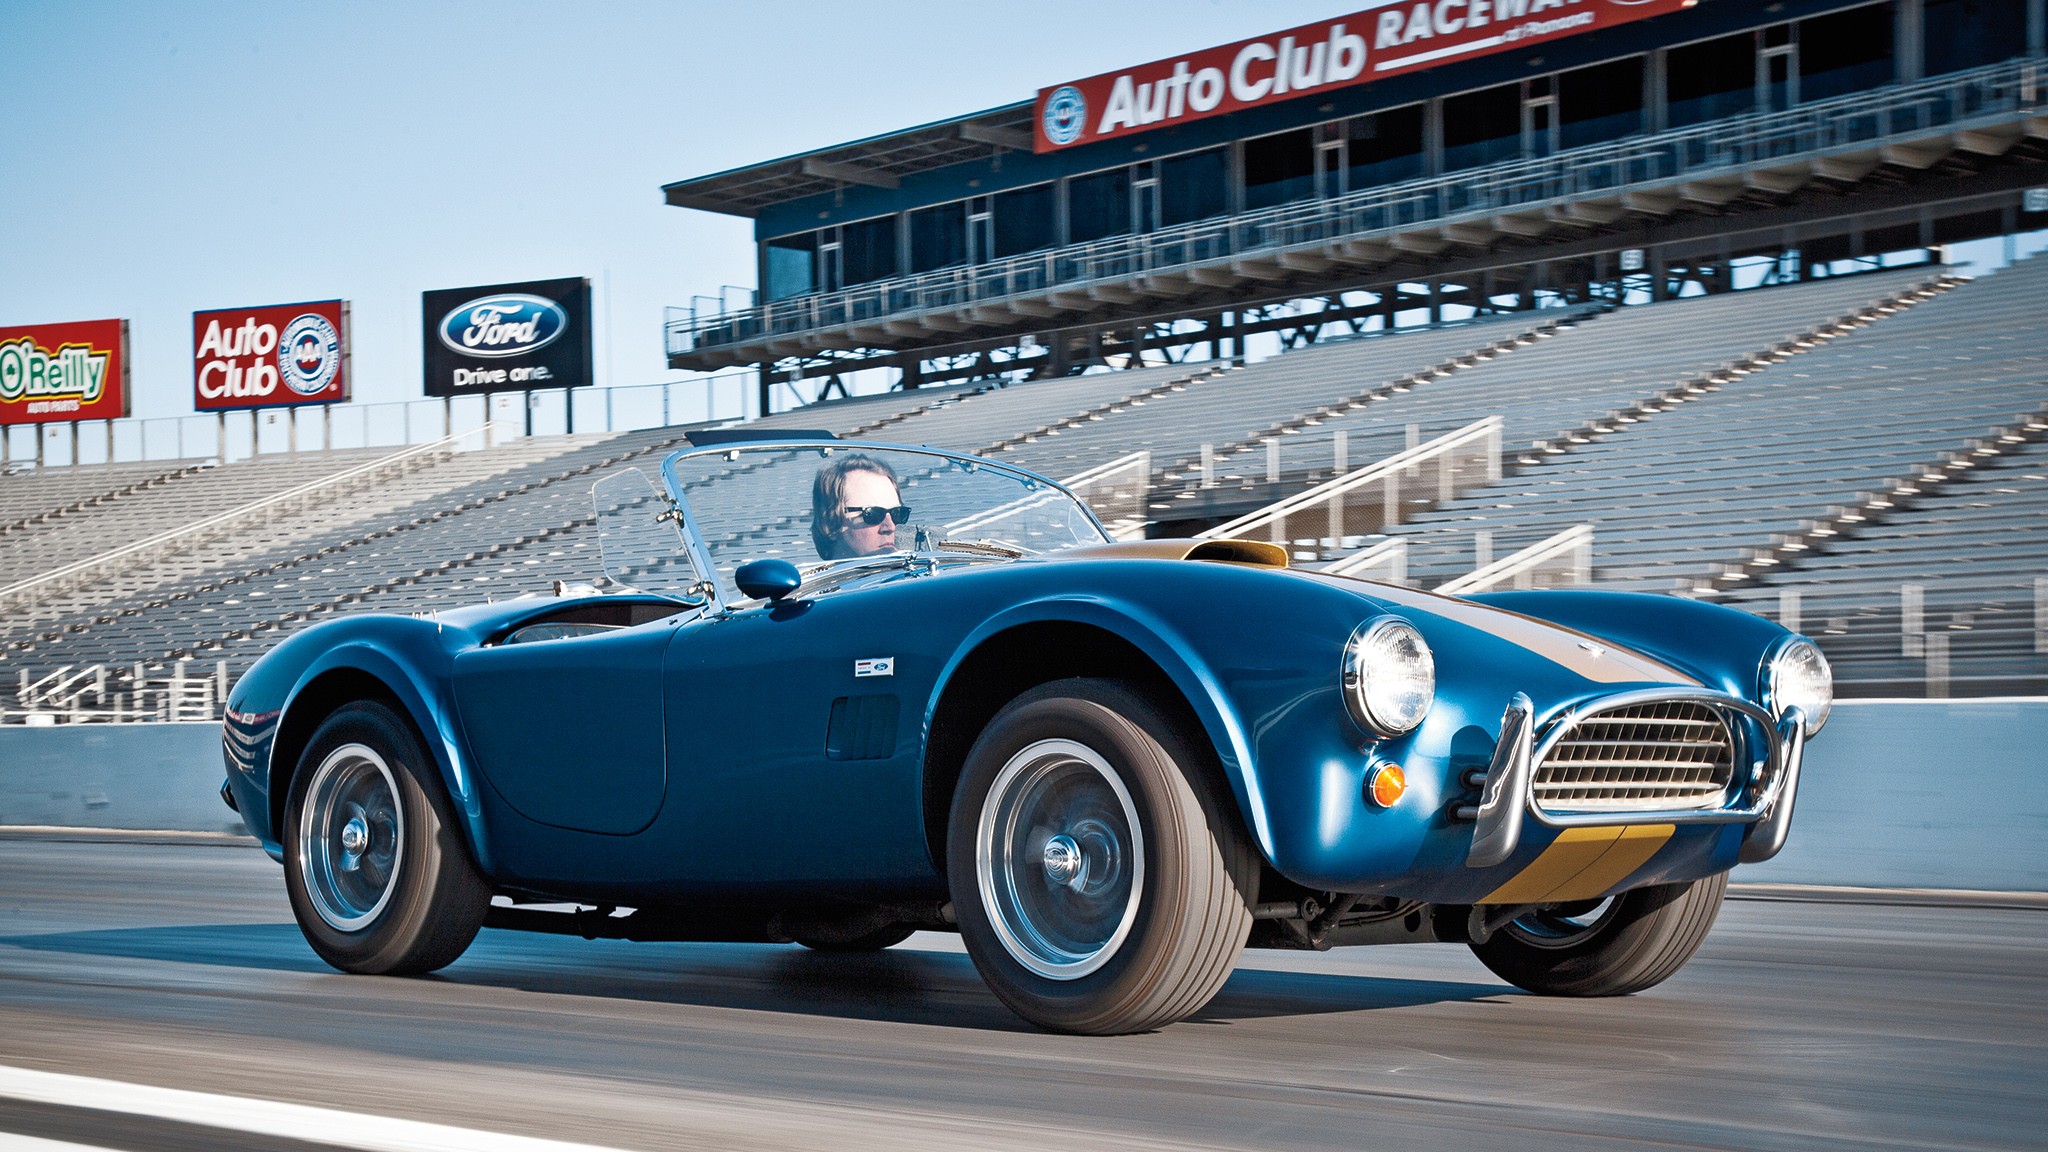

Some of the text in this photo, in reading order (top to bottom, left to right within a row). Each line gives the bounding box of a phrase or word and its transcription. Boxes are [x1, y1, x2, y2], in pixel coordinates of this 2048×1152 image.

[1374, 0, 1584, 50] RACEW
[1097, 60, 1226, 135] Auto
[1229, 23, 1368, 102] Club
[196, 316, 278, 359] Auto
[462, 304, 543, 347] Ford
[0, 344, 103, 396] O'Reilly
[198, 356, 279, 399] Club
[453, 367, 507, 386] Drive
